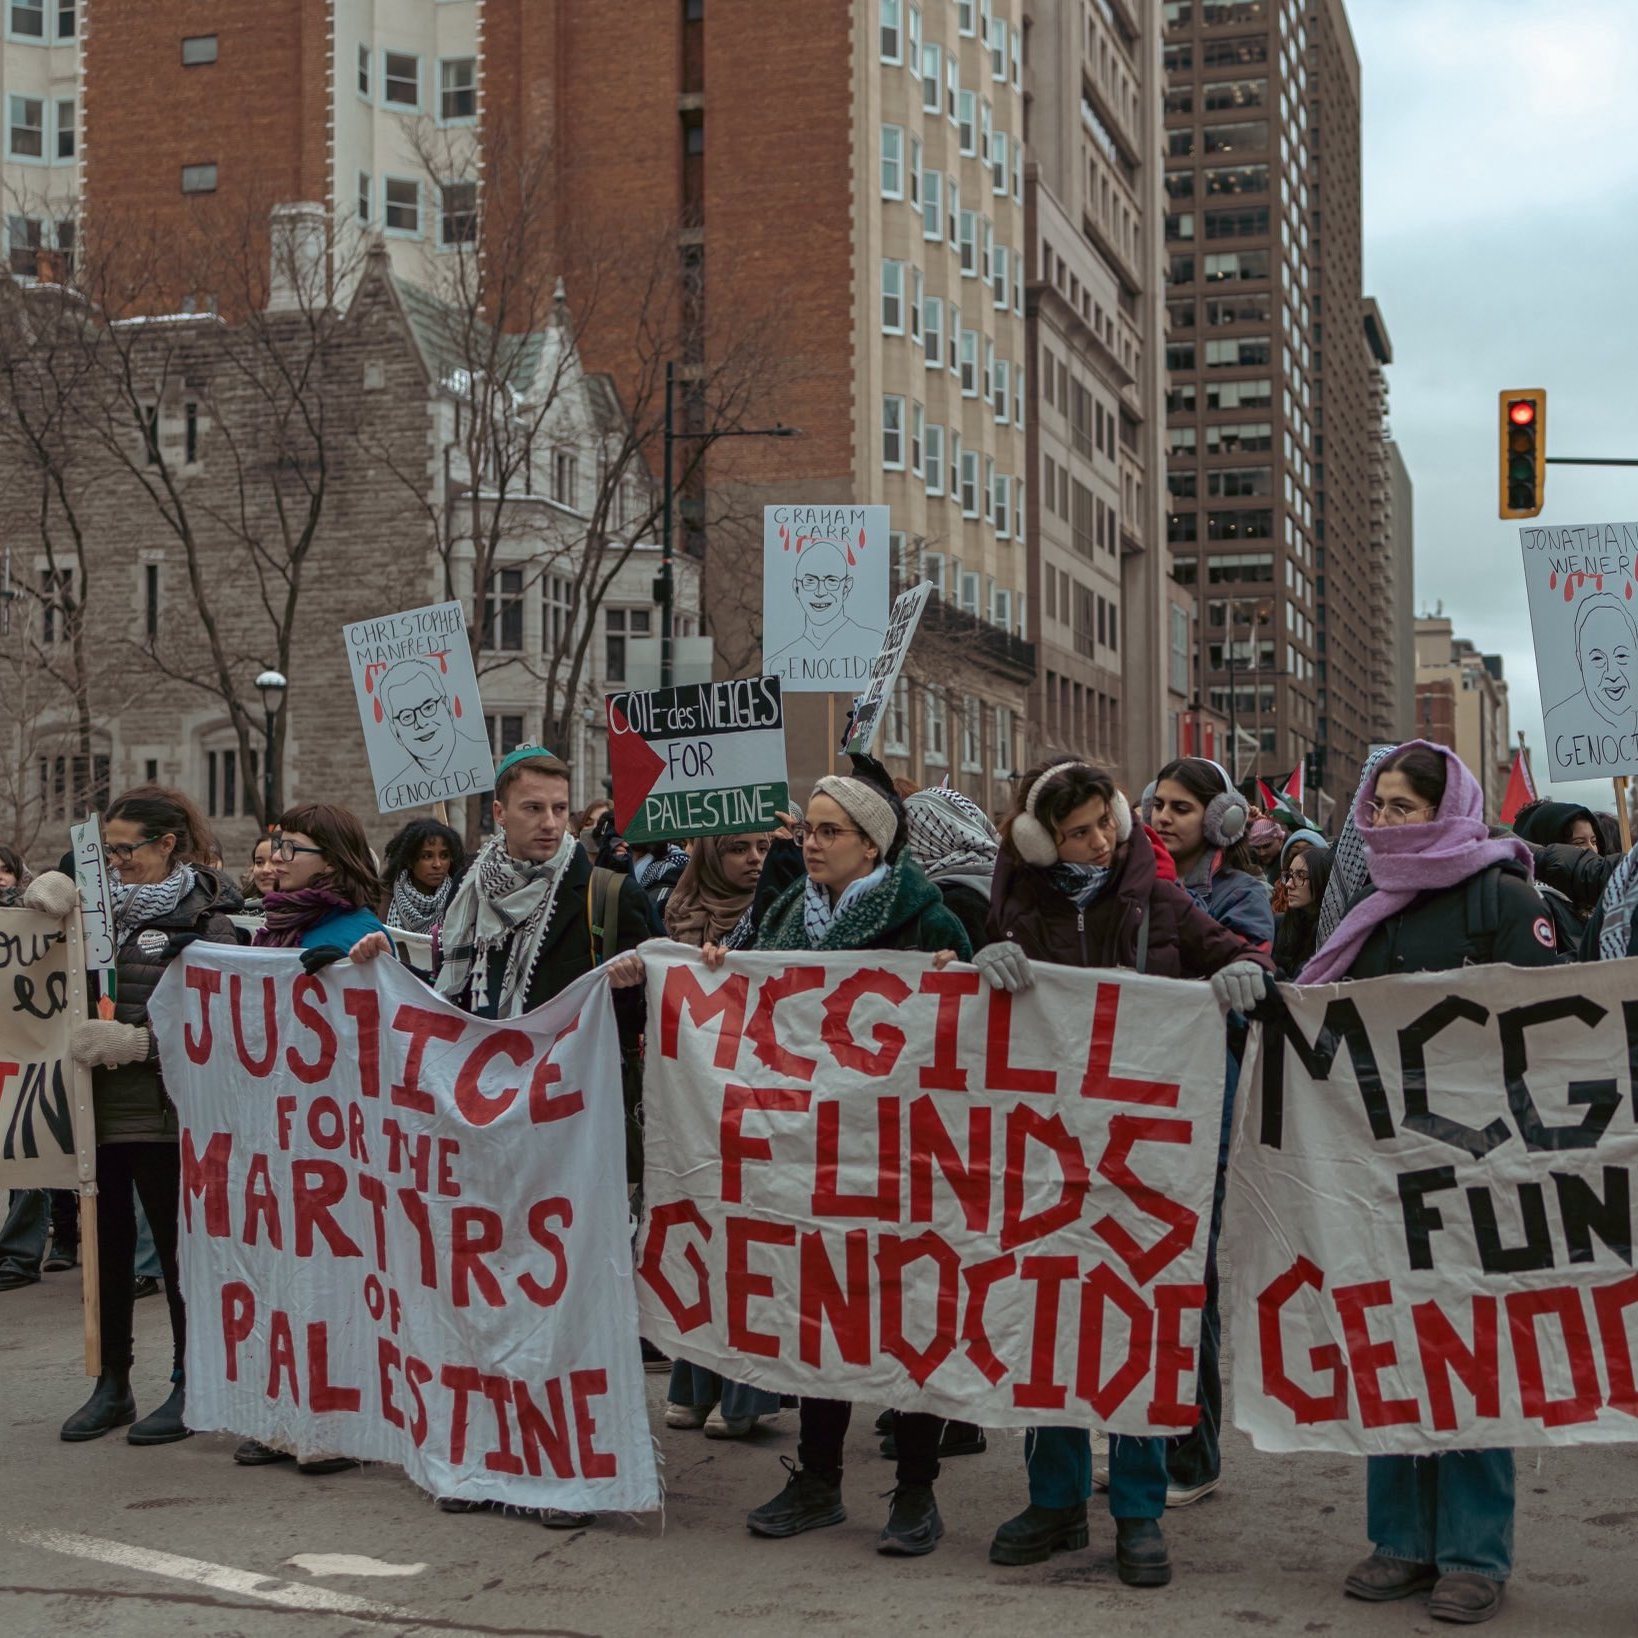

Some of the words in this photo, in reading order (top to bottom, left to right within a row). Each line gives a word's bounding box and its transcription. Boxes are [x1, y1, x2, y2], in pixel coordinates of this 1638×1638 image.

[774, 508, 865, 526] GRAHAM
[795, 525, 851, 540] CARR
[1525, 525, 1638, 553] JONATHAN
[1549, 556, 1632, 577] WENER
[351, 607, 465, 646] CHRISTOPHER
[356, 634, 452, 665] MANFREDI
[386, 767, 488, 809] GENOCIDE
[668, 741, 714, 780] FOR
[645, 785, 775, 832] PALESTINE
[81, 843, 113, 963] فلسطين
[185, 966, 585, 1128] JUSTICE
[661, 964, 1181, 1108] MCGILL
[278, 1095, 370, 1163] FOR
[382, 1119, 461, 1197] THE
[719, 1084, 1199, 1287] FUNDS
[181, 1129, 574, 1308] MARTYRS
[1397, 1165, 1632, 1275] FUN
[364, 1273, 401, 1335] OF
[637, 1200, 1207, 1427] GENOCIDE
[220, 1281, 618, 1479] PALESTINE
